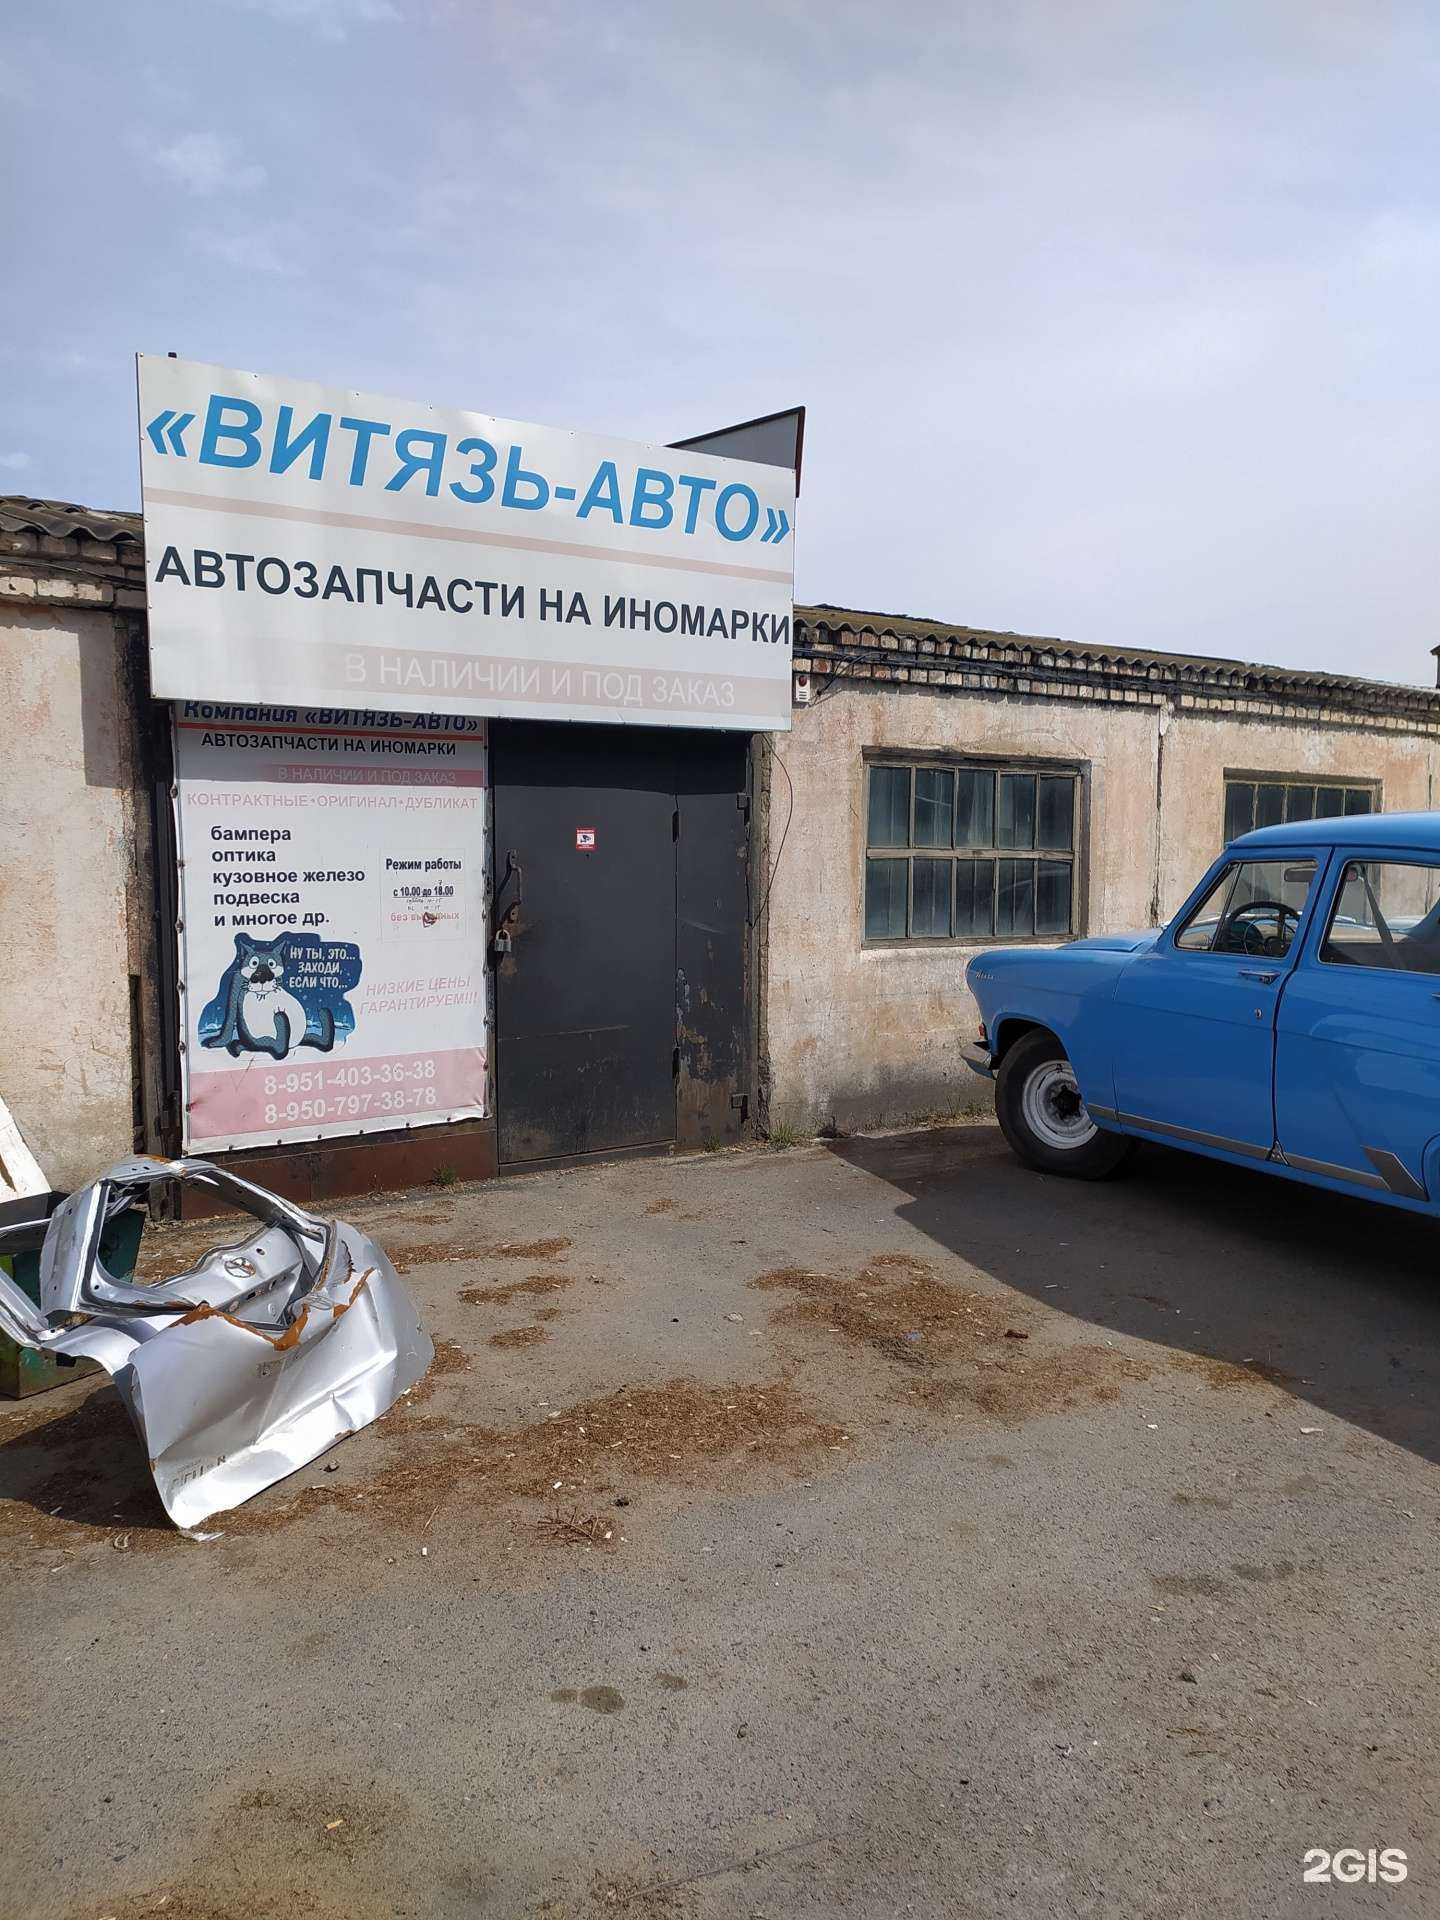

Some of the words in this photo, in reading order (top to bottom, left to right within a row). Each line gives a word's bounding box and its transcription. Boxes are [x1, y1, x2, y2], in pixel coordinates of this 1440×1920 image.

[146, 394, 790, 544] «ВИТЯЗЬ-АВТО»
[155, 546, 526, 619] АВТОЗАПЧАСТИ
[539, 588, 591, 627] НА
[603, 595, 791, 645] ИНОМАРКИ
[345, 654, 366, 682] В
[380, 656, 540, 694] НАЛИЧИИ
[552, 670, 571, 696] И
[582, 672, 642, 706] ПОД
[652, 676, 734, 707] ЗАКАЗ
[184, 701, 297, 722] Компания
[201, 733, 339, 751] АВТОЗАПЧАСТИ
[344, 738, 366, 752] НА
[370, 740, 456, 755] ИНОМАРКИ
[278, 768, 288, 780] В
[293, 768, 364, 782] НАЛИЧИИ
[367, 771, 377, 782] И
[381, 770, 410, 784] ПОД
[414, 772, 456, 784] ЗАКАЗ
[210, 826, 291, 844] бампера
[212, 850, 276, 862] оптика
[385, 858, 421, 870] Режим
[425, 858, 461, 872] работы
[213, 871, 297, 887] кузовное
[303, 870, 365, 882] железо
[213, 892, 300, 906] подвеска
[214, 915, 225, 926] и
[232, 913, 297, 925] многое
[302, 912, 329, 926] др.
[390, 912, 408, 922] без
[290, 946, 303, 960] НУ
[289, 976, 317, 988] ЕСЛИ
[366, 979, 424, 996] НИЗКИЕ
[428, 976, 471, 992] ЦЕНЫ
[264, 1060, 436, 1096] 8-951-403-36-38
[264, 1086, 437, 1124] 8-950-797-38-78
